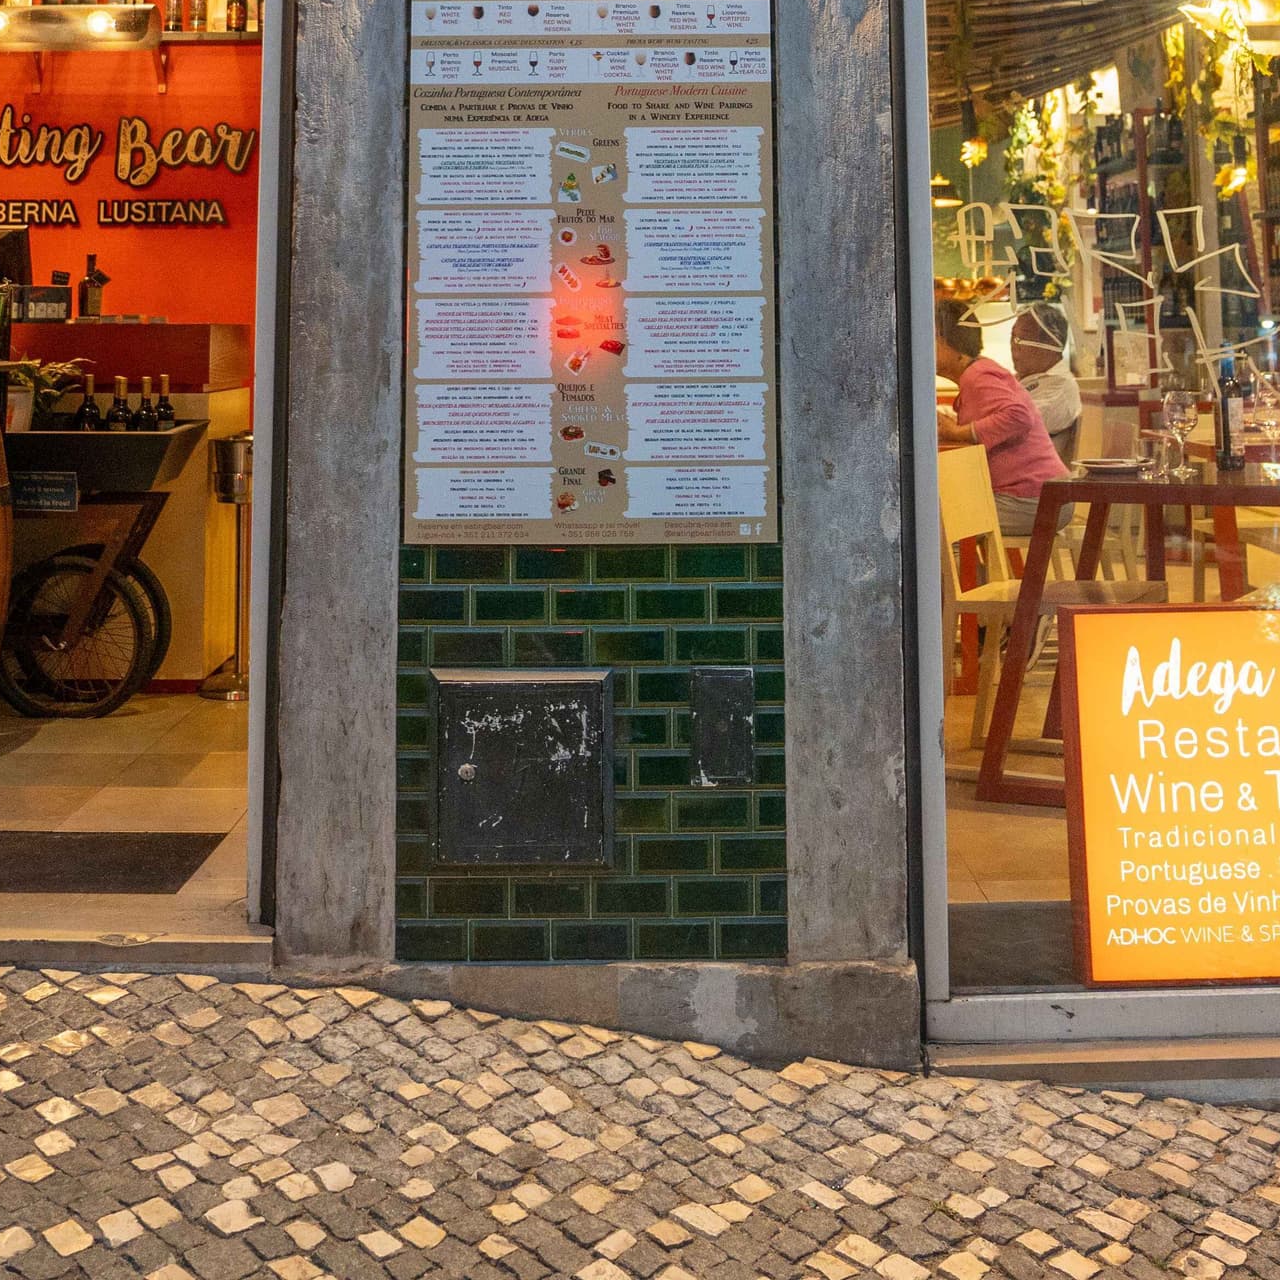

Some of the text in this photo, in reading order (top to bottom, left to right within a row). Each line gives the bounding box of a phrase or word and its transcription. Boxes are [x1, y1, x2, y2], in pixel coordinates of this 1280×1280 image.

[413, 87, 453, 99] Cozinha
[454, 87, 505, 100] Portuguesa
[614, 84, 748, 98] Portuguese Modern Cuisine
[607, 102, 628, 110] FOOD
[646, 102, 670, 110] SHARE
[694, 101, 715, 109] WINE
[115, 116, 256, 186] Bear
[592, 138, 620, 147] GREENS
[98, 199, 225, 225] LUSITANA
[557, 215, 583, 224] FRUTOS
[599, 215, 615, 224] MAR
[558, 466, 586, 475] GRANDE
[562, 477, 582, 485] FINAL
[1121, 637, 1276, 716] Adega
[1109, 771, 1224, 815] Wine
[1236, 782, 1259, 811] &
[1117, 822, 1276, 849] Tradicional
[1119, 859, 1261, 886] Portuguese
[1106, 893, 1192, 916] Provas
[1198, 892, 1227, 914] de
[1106, 926, 1176, 946] ADHOC
[1180, 925, 1234, 944] WINE
[1240, 924, 1254, 943] &
